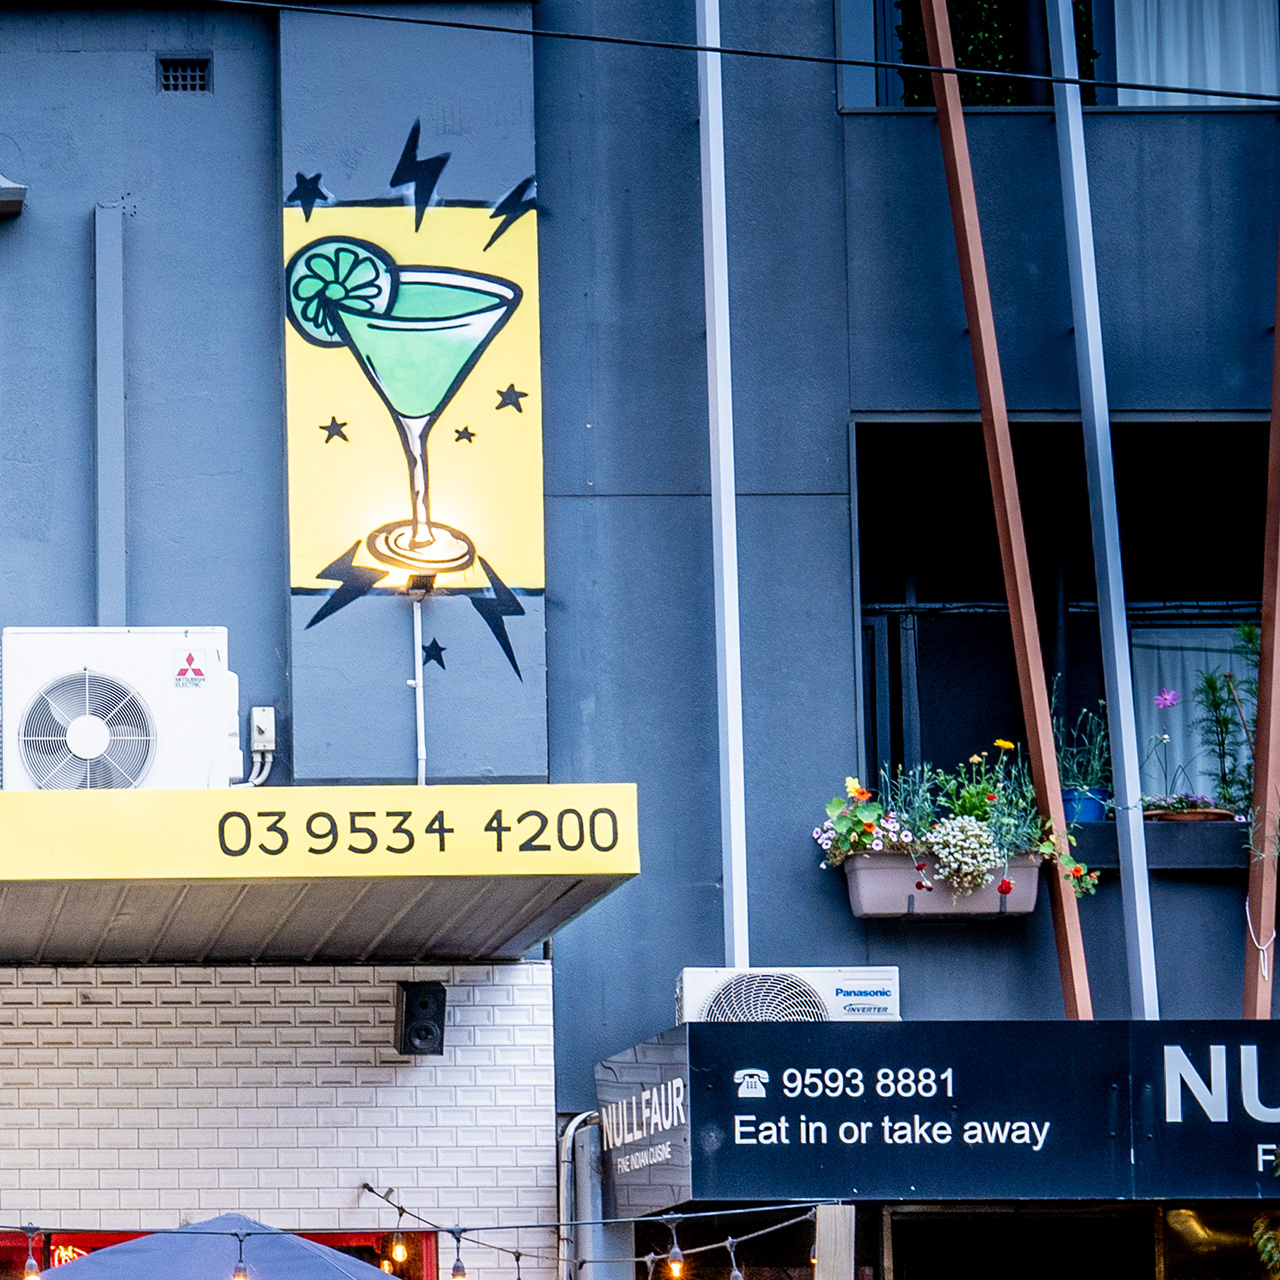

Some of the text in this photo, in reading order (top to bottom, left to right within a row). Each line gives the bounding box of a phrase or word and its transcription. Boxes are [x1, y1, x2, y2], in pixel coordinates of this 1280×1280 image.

[218, 806, 619, 857] 03 9534 4200
[835, 987, 892, 997] Panasonic
[782, 1067, 955, 1099] 9593 8881
[601, 1077, 686, 1151] NULLFAUR
[734, 1114, 1051, 1152] Eat in or take away
[617, 1141, 672, 1174] FINE INDIAN CUISINE
